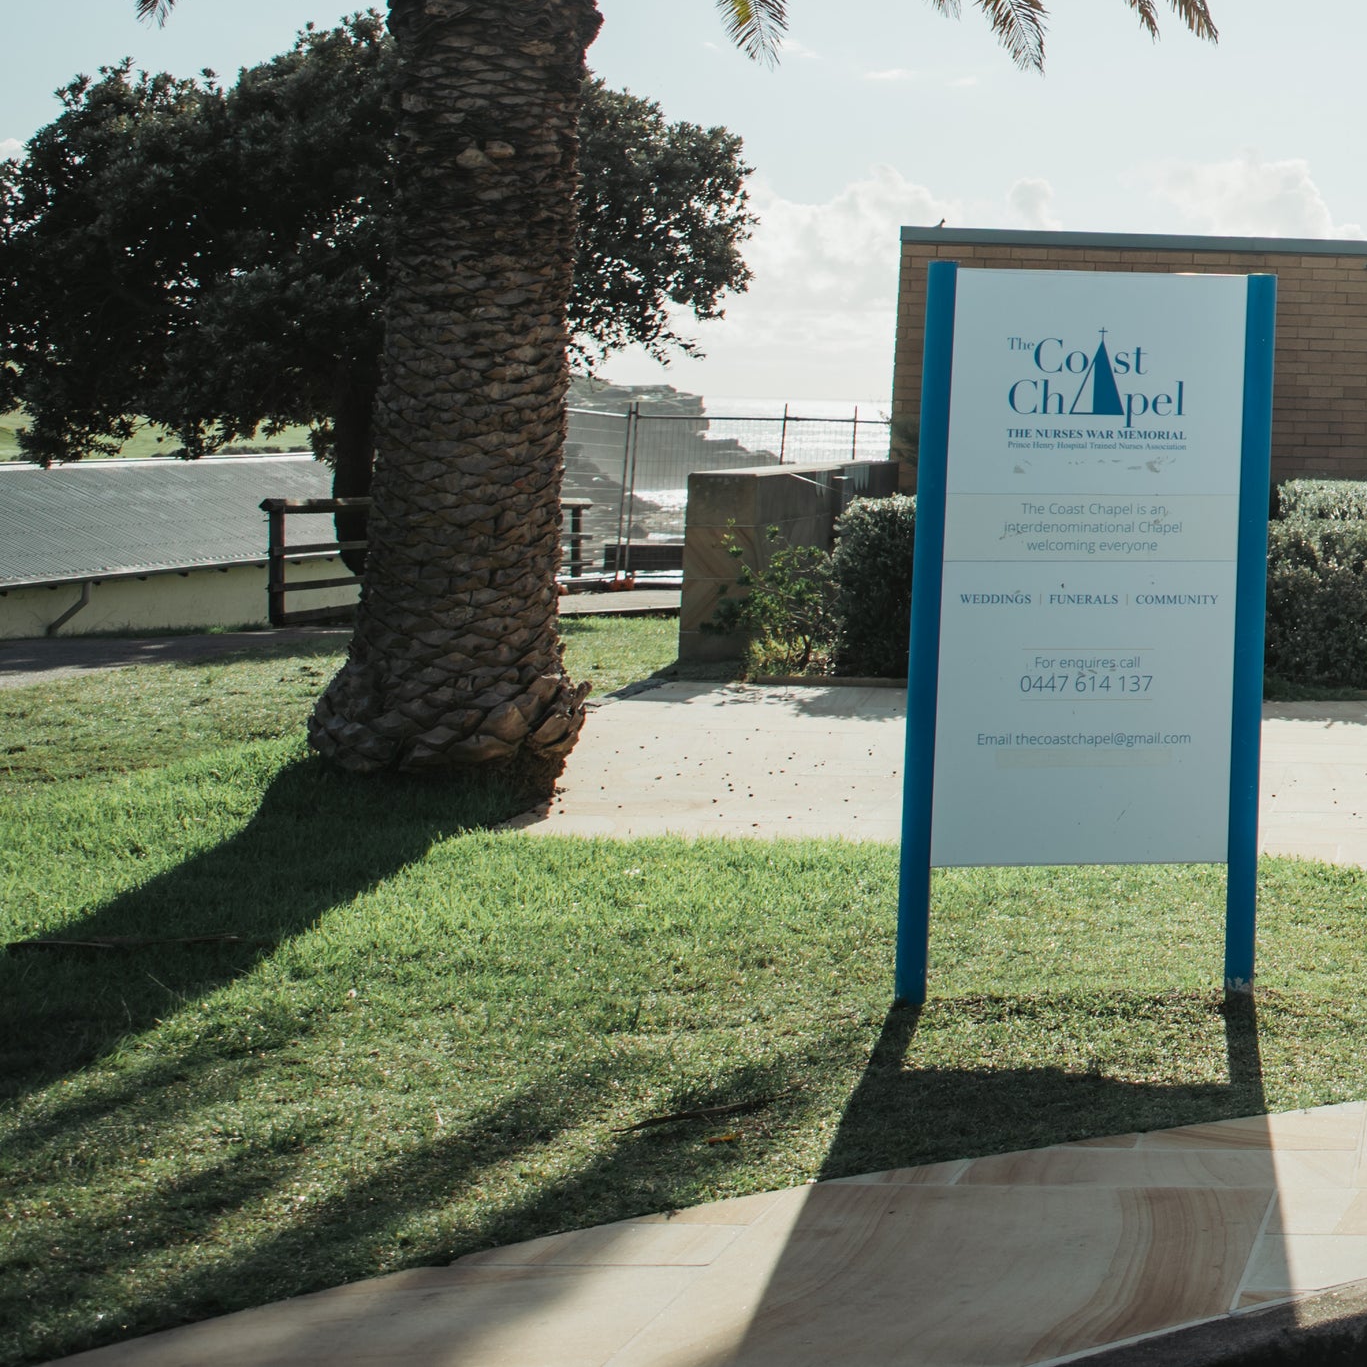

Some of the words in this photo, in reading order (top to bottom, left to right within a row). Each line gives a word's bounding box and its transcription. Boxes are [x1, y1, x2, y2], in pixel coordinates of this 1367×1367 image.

[1007, 337, 1035, 350] The
[1007, 428, 1032, 439] THE
[1035, 429, 1083, 439] NURSES
[1086, 429, 1114, 440] WAR
[1117, 430, 1187, 441] MEMORIAL
[1007, 440, 1031, 449] Prince
[1032, 441, 1055, 451] Henry
[1057, 441, 1088, 451] Hospital
[1090, 442, 1117, 450] Trained
[1119, 442, 1143, 450] Nurses
[1145, 442, 1187, 451] Association
[1021, 503, 1045, 515] The
[1049, 503, 1085, 515] Coast
[1089, 503, 1133, 518] Chapel
[1136, 503, 1147, 515] is
[1150, 505, 1166, 515] an
[1004, 521, 1135, 534] interdenominational
[1138, 522, 1182, 536] Chapel
[1027, 540, 1096, 554] welcoming
[1099, 542, 1158, 554] everyone
[960, 594, 1032, 605] WEDDINGS
[1049, 594, 1119, 605] FUNERALS
[1135, 594, 1219, 605] COMMUNITY
[1035, 657, 1056, 669] For
[1059, 657, 1116, 671] enquires
[1119, 656, 1141, 669] call
[1020, 675, 1069, 693] 0447
[1075, 675, 1112, 693] 614
[1118, 675, 1153, 693] 137
[977, 733, 1012, 746] Email
[1016, 732, 1192, 748] thecoastchapel@gmail.com
